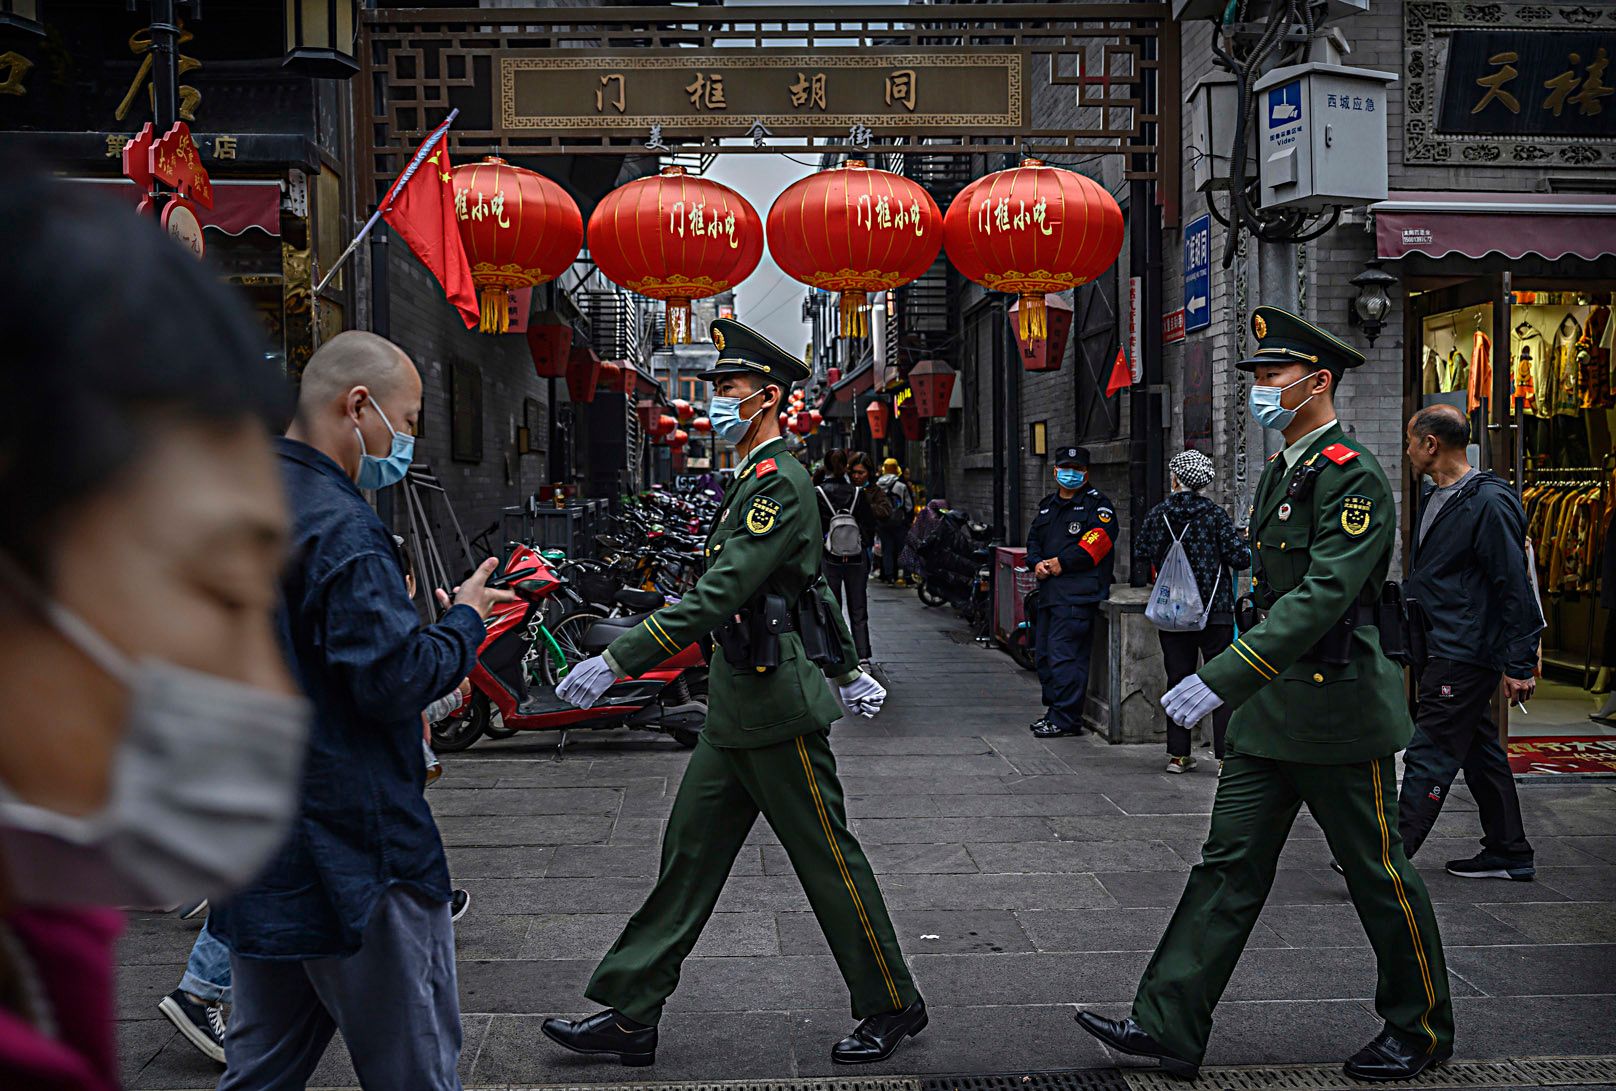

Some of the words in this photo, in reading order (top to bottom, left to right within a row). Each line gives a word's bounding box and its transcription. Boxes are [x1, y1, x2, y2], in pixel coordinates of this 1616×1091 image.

[595, 70, 917, 113] 门框胡同
[1327, 93, 1376, 112] 西城应急
[645, 119, 874, 151] 美食街
[1277, 137, 1295, 146] Video
[670, 201, 738, 249] 门框小吃
[857, 194, 923, 237] 门框小吃
[978, 196, 1053, 236] 门框小吃
